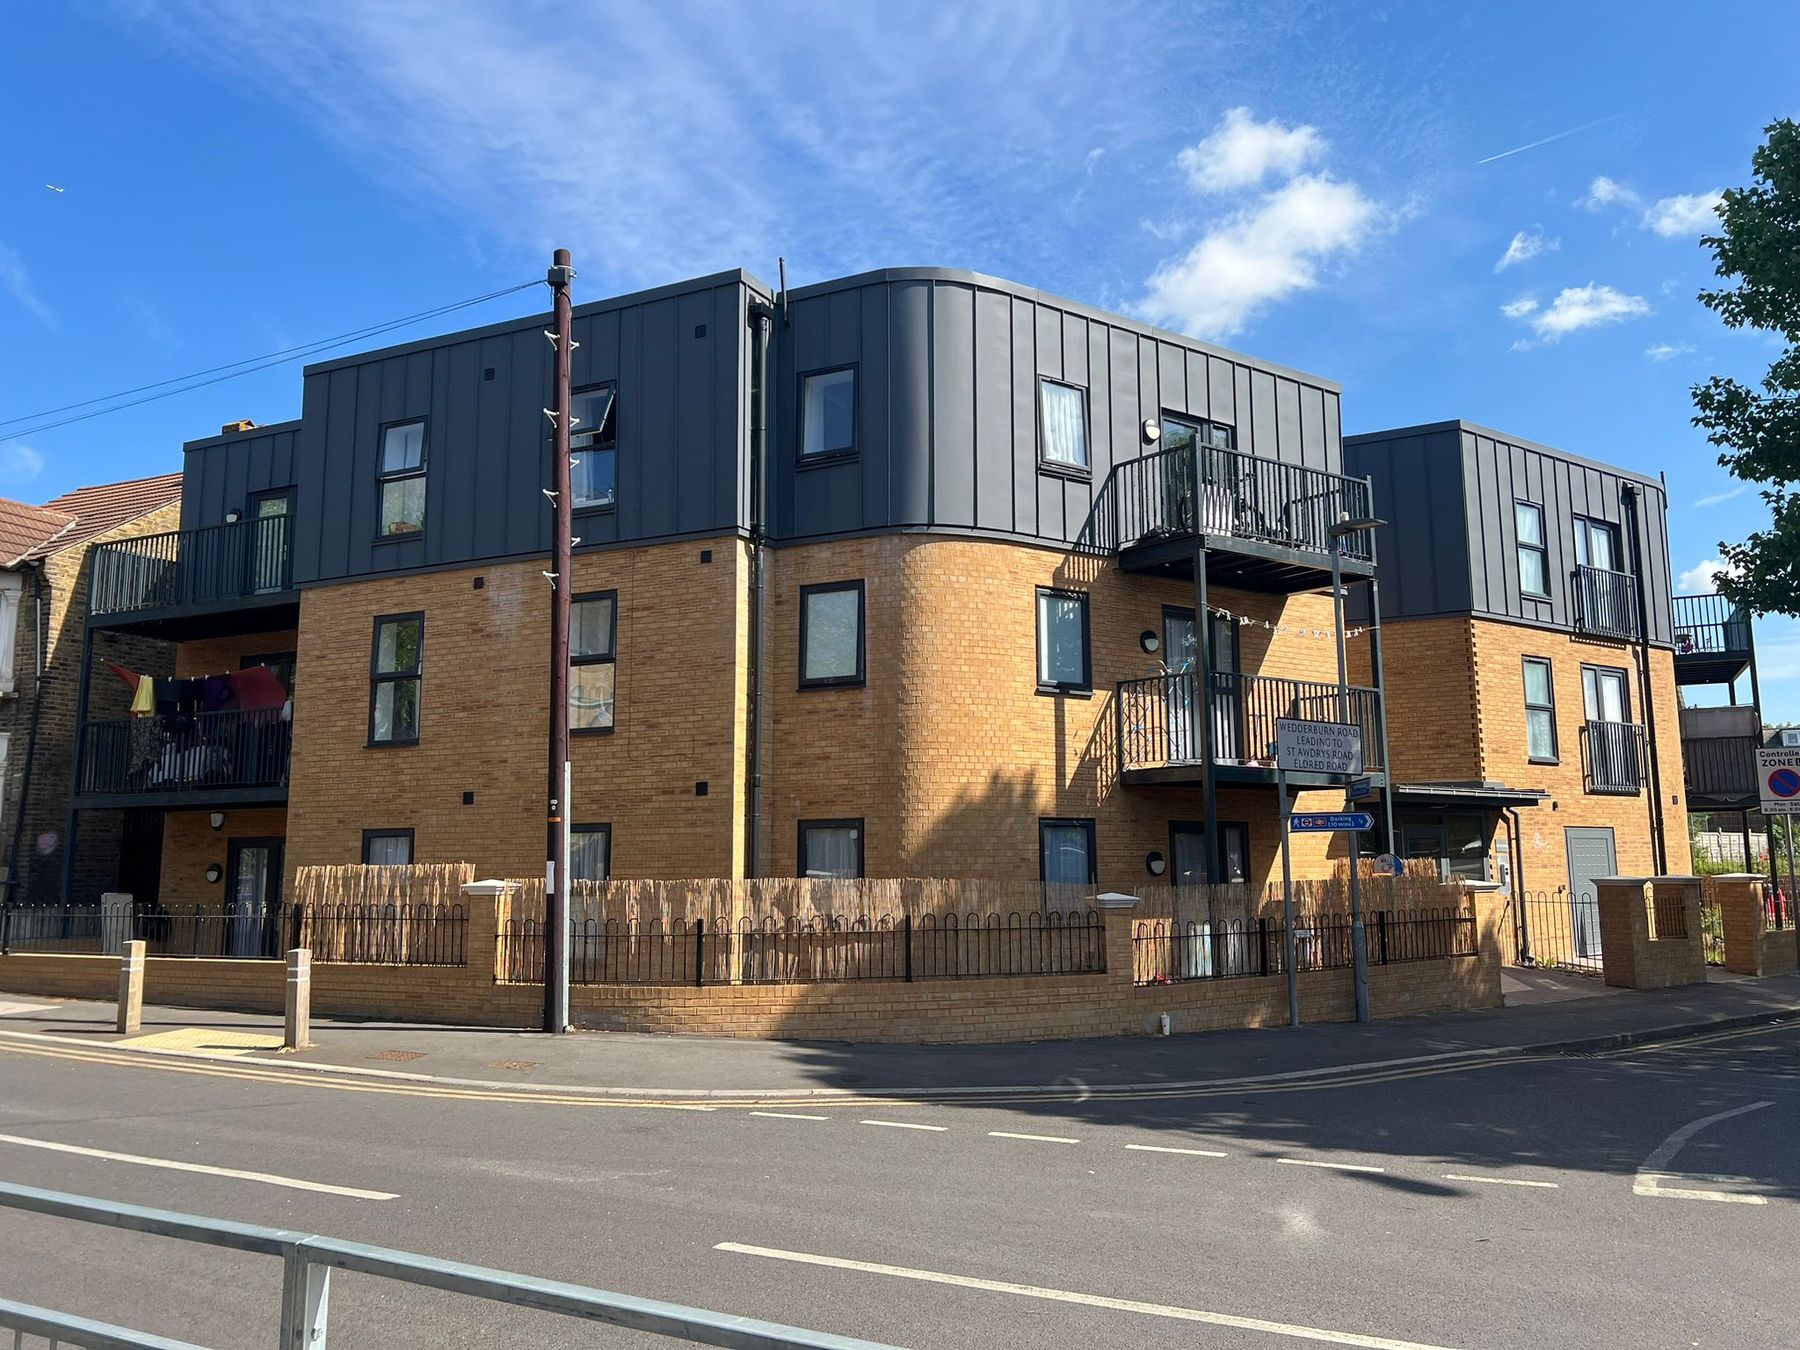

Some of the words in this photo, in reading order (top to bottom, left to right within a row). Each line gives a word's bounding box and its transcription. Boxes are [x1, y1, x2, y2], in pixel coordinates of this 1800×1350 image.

[1279, 722, 1335, 736] WEDDERBURN
[1337, 727, 1358, 738] ROAD
[1296, 736, 1331, 747] LEADING
[1332, 738, 1343, 748] TO
[1286, 746, 1296, 756] ST
[1297, 747, 1331, 759] AWDRYS
[1332, 750, 1354, 761] ROAD
[1759, 750, 1800, 758] Controlle
[1294, 759, 1325, 770] ELDRED
[1326, 761, 1348, 772] ROAD
[1761, 758, 1794, 767] ZONE
